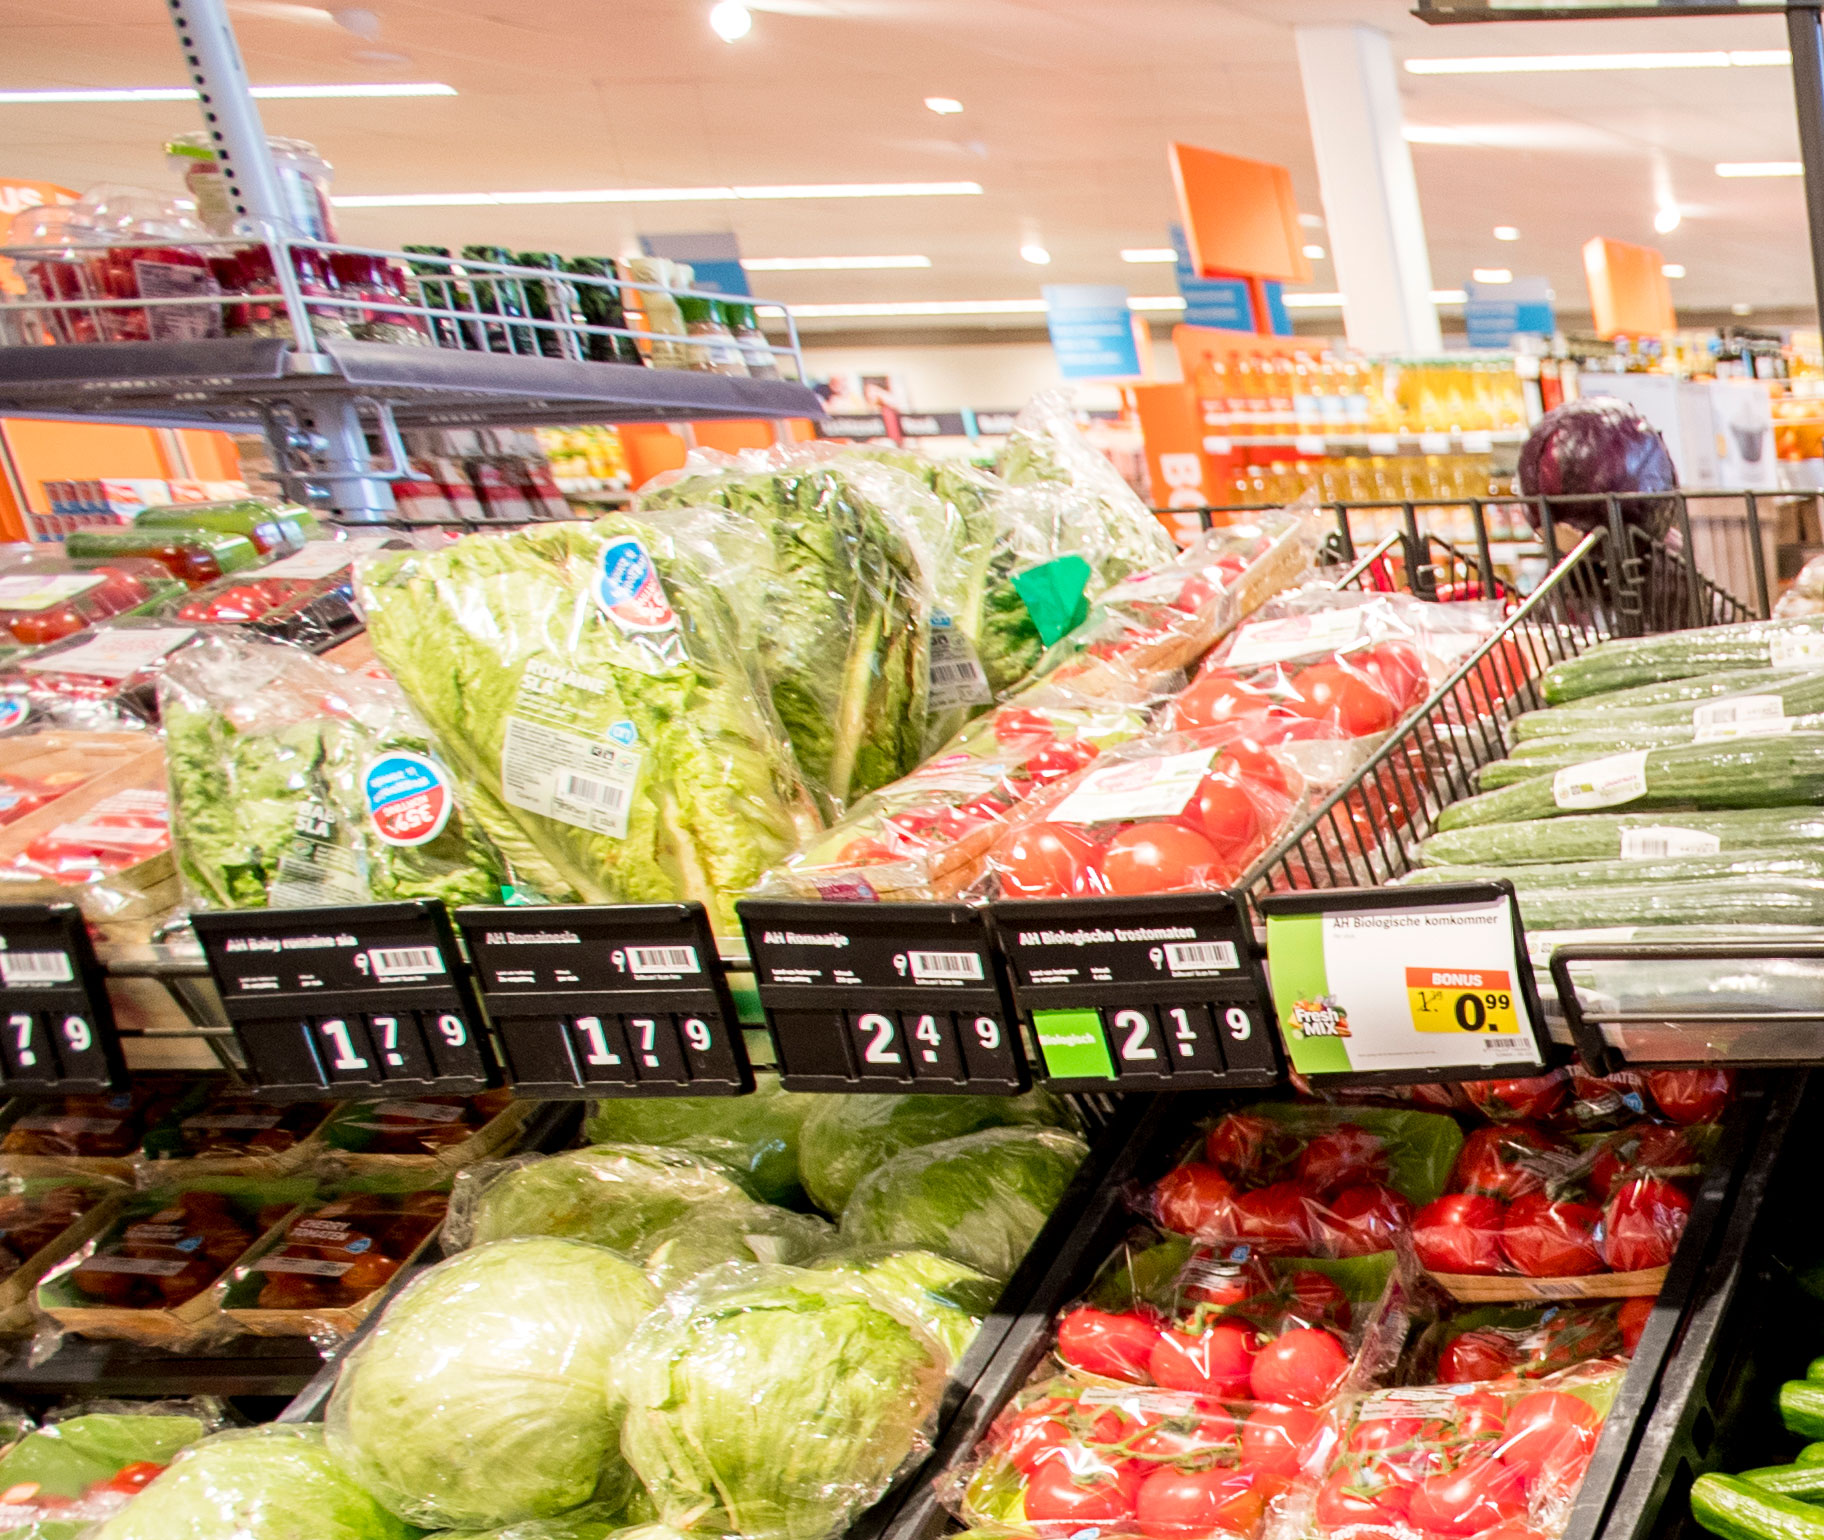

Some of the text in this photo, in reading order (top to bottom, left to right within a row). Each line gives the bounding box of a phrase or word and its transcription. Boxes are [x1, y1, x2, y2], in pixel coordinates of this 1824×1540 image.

[521, 674, 554, 695] SLA
[526, 658, 607, 694] ROMAINE
[295, 816, 330, 837] SLA
[1333, 914, 1499, 930] AH Biologische komkommer
[763, 932, 785, 945] AH
[1018, 927, 1197, 946] AH Biologische trostomaten
[1431, 972, 1483, 987] BONUS
[1294, 1008, 1340, 1024] Fresh
